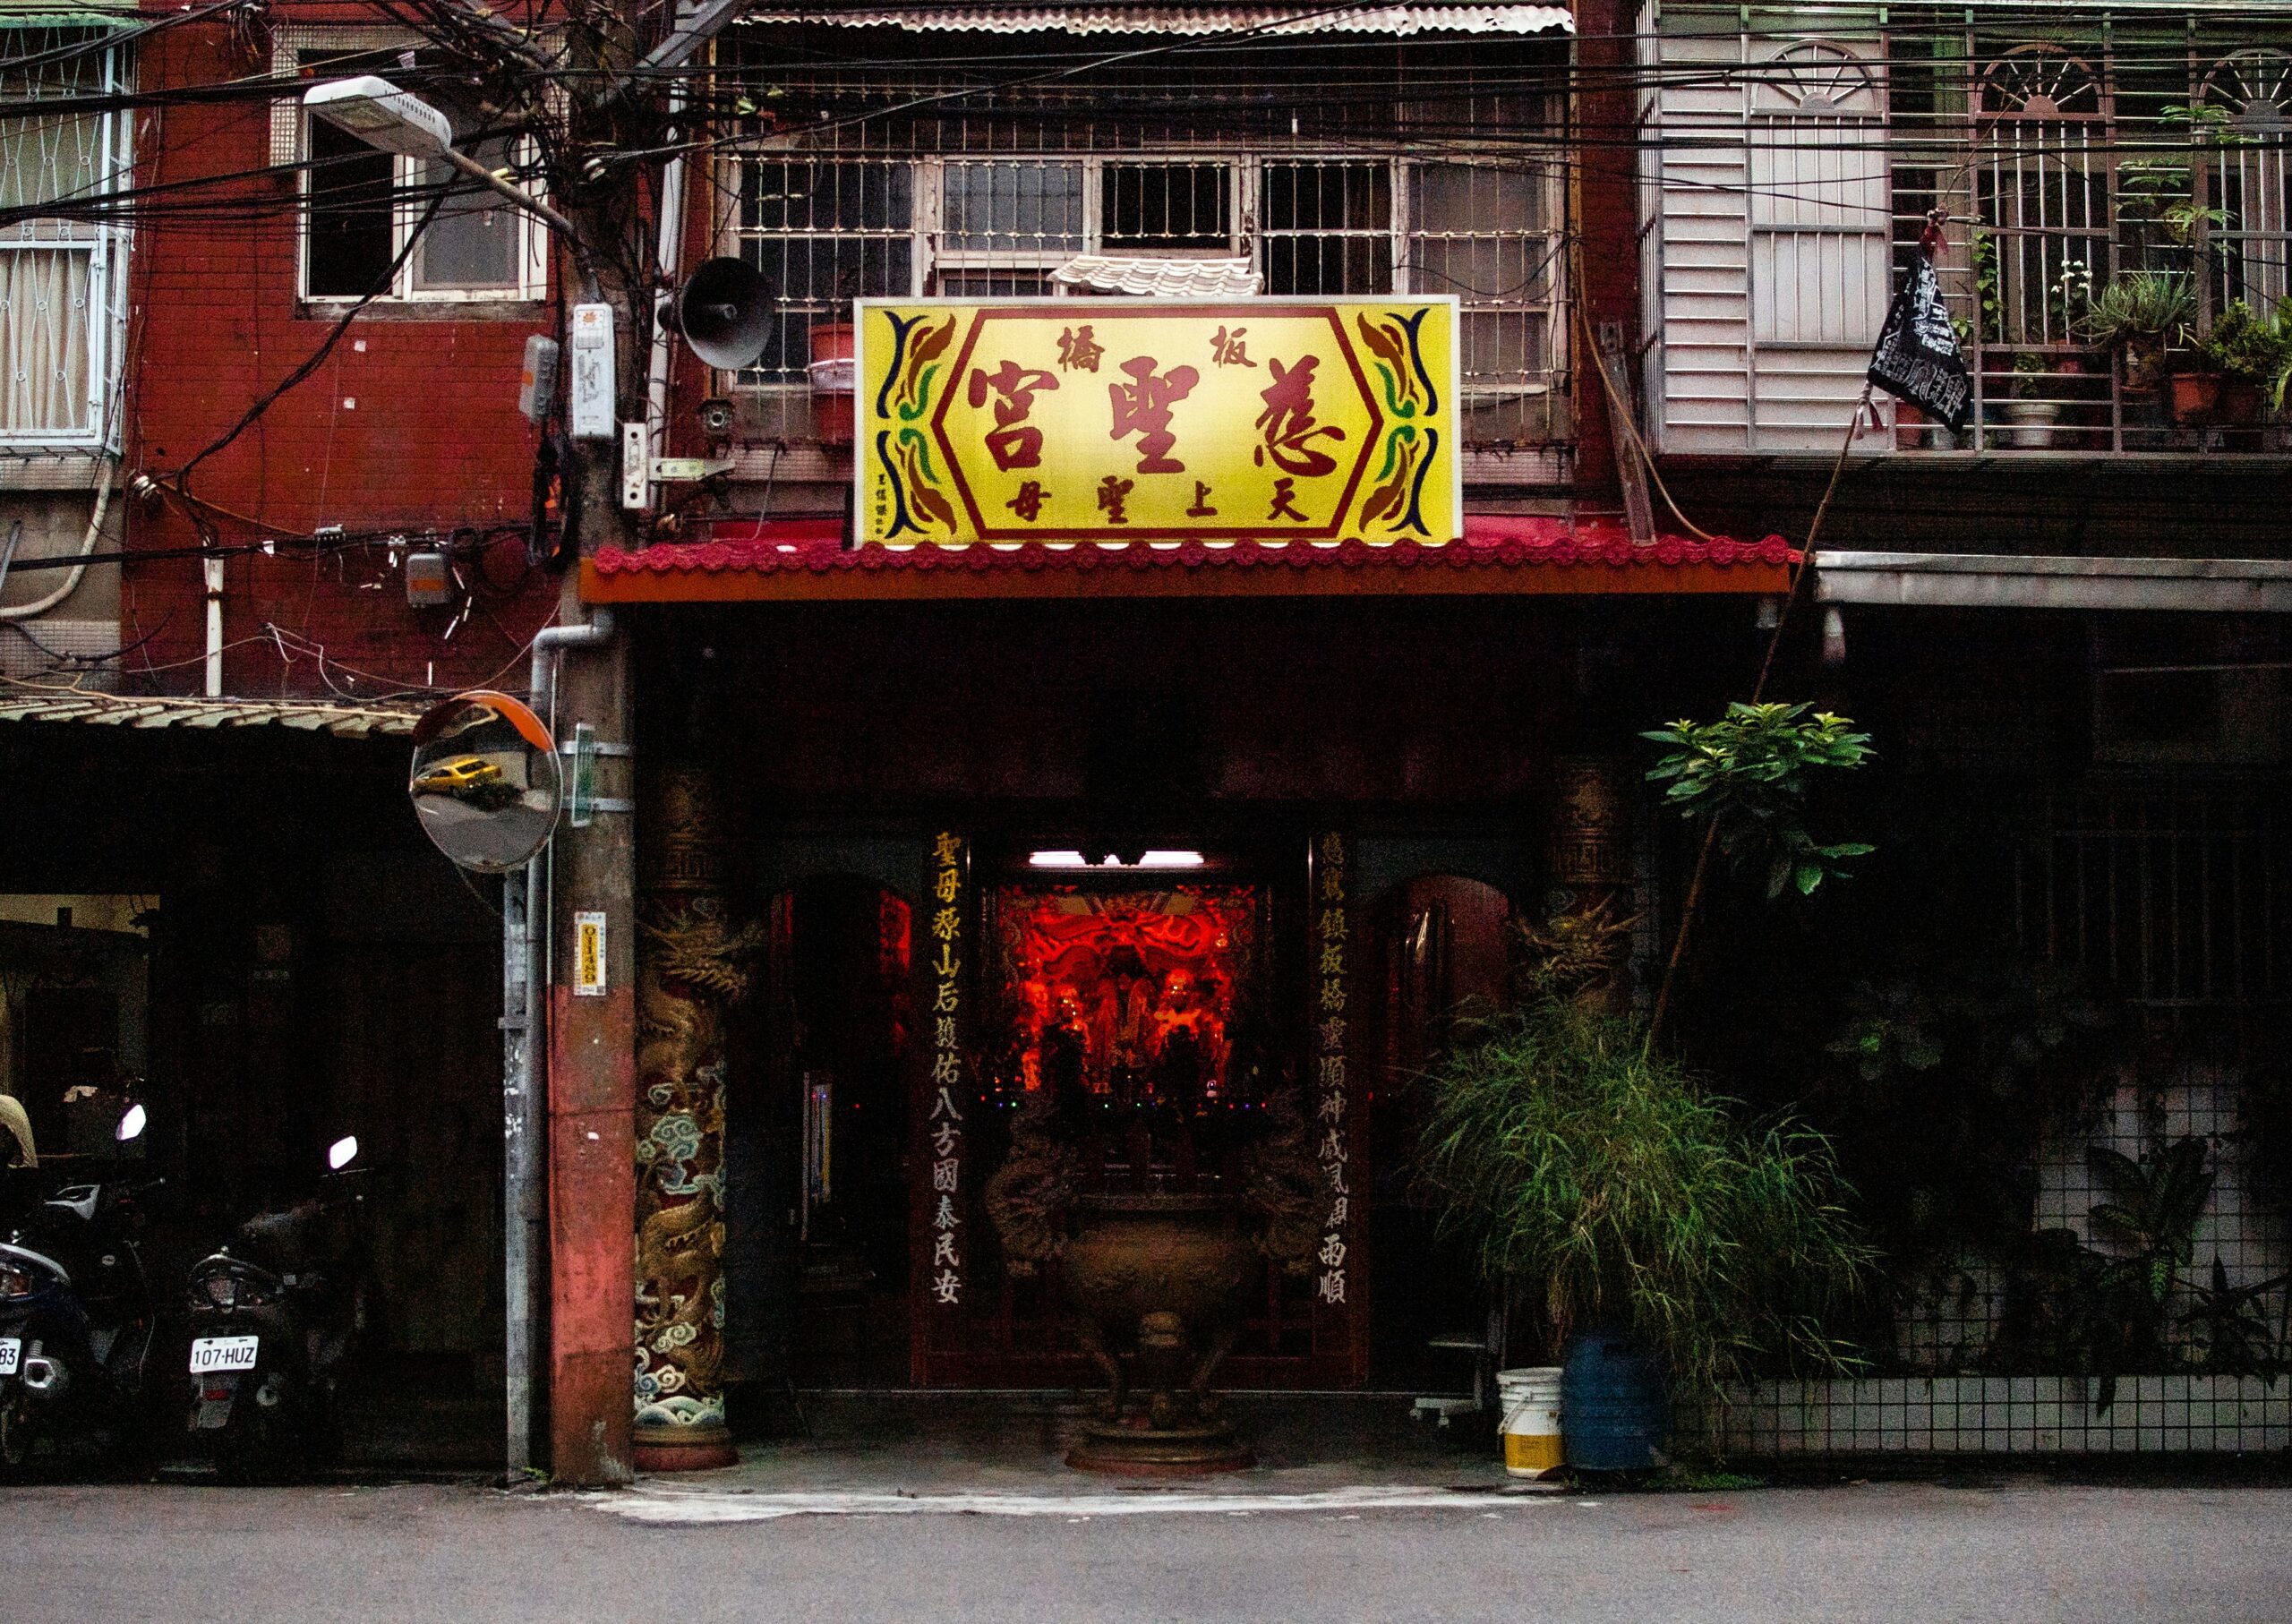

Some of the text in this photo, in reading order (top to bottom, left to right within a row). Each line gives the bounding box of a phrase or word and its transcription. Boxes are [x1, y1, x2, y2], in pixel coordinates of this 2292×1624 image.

[1057, 325, 1257, 372] 板橋
[968, 355, 1345, 477] 慈聖宮
[1005, 475, 1309, 524] 天上聖母
